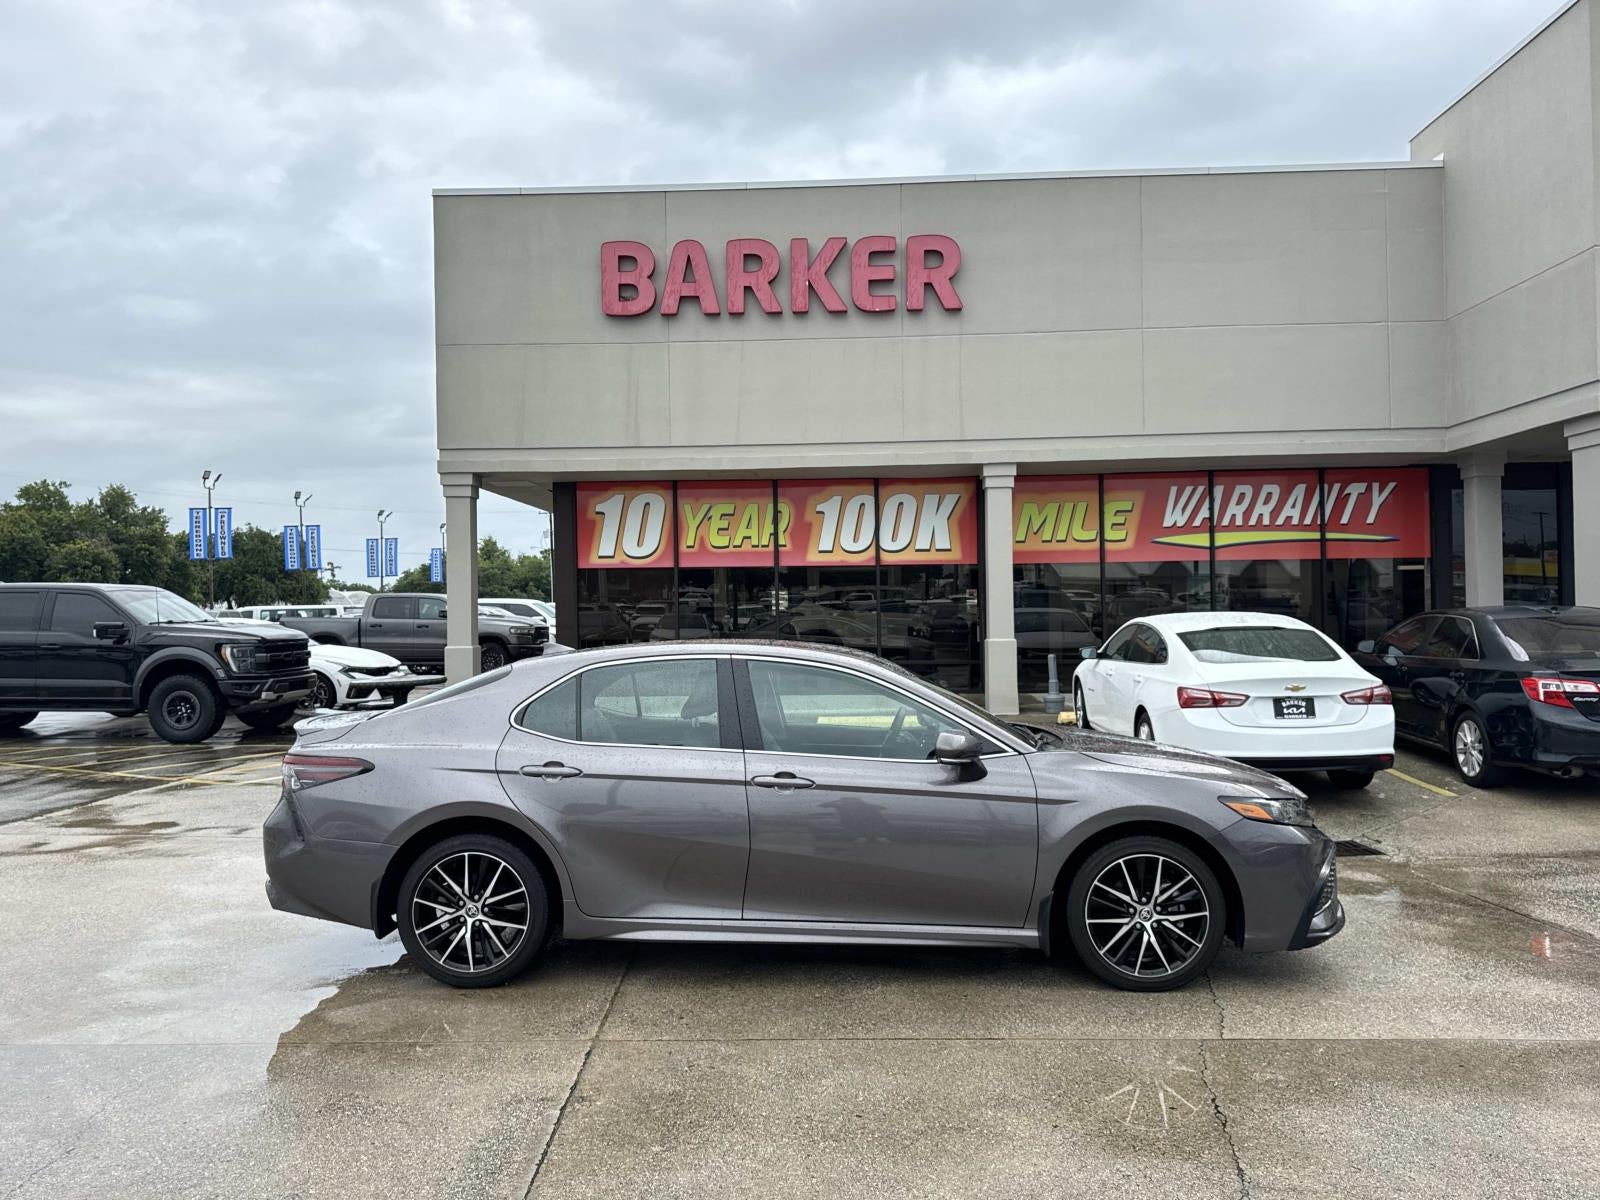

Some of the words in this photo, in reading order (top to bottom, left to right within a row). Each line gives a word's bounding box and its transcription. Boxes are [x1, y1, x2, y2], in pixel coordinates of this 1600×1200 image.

[599, 235, 963, 317] BARKER
[595, 492, 665, 558] 10
[683, 503, 791, 549] YEAR
[815, 493, 961, 553] 100K
[1015, 500, 1136, 545] MILE
[1162, 481, 1398, 528] WARRANTY
